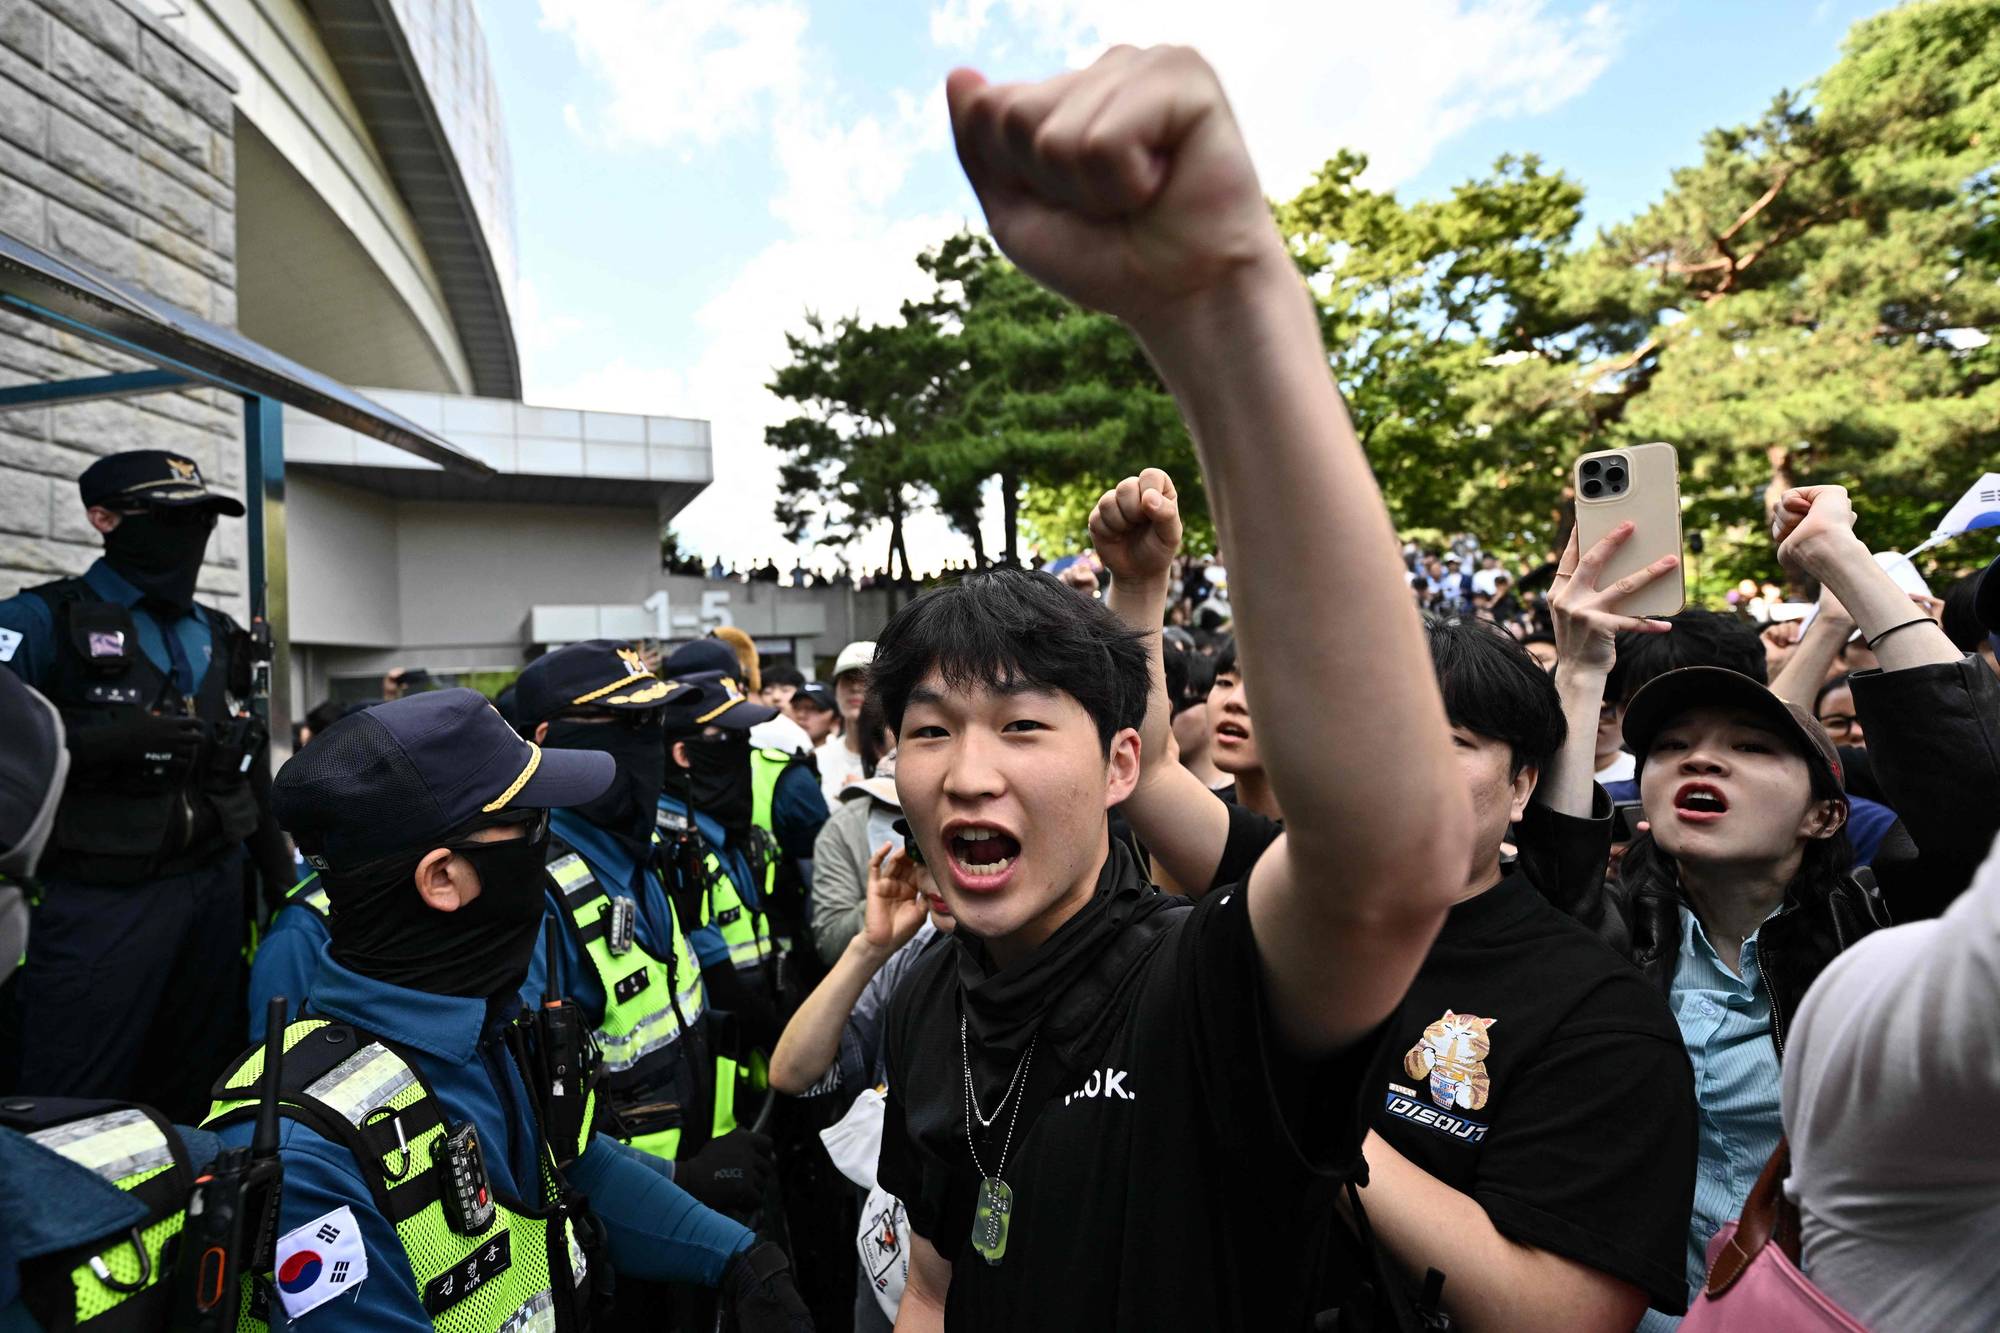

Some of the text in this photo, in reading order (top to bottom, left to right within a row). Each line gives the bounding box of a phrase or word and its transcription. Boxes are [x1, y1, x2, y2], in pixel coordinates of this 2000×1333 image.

[644, 590, 733, 639] 1-5
[1388, 1098, 1489, 1141] DISOUT
[714, 1167, 745, 1180] POLICE
